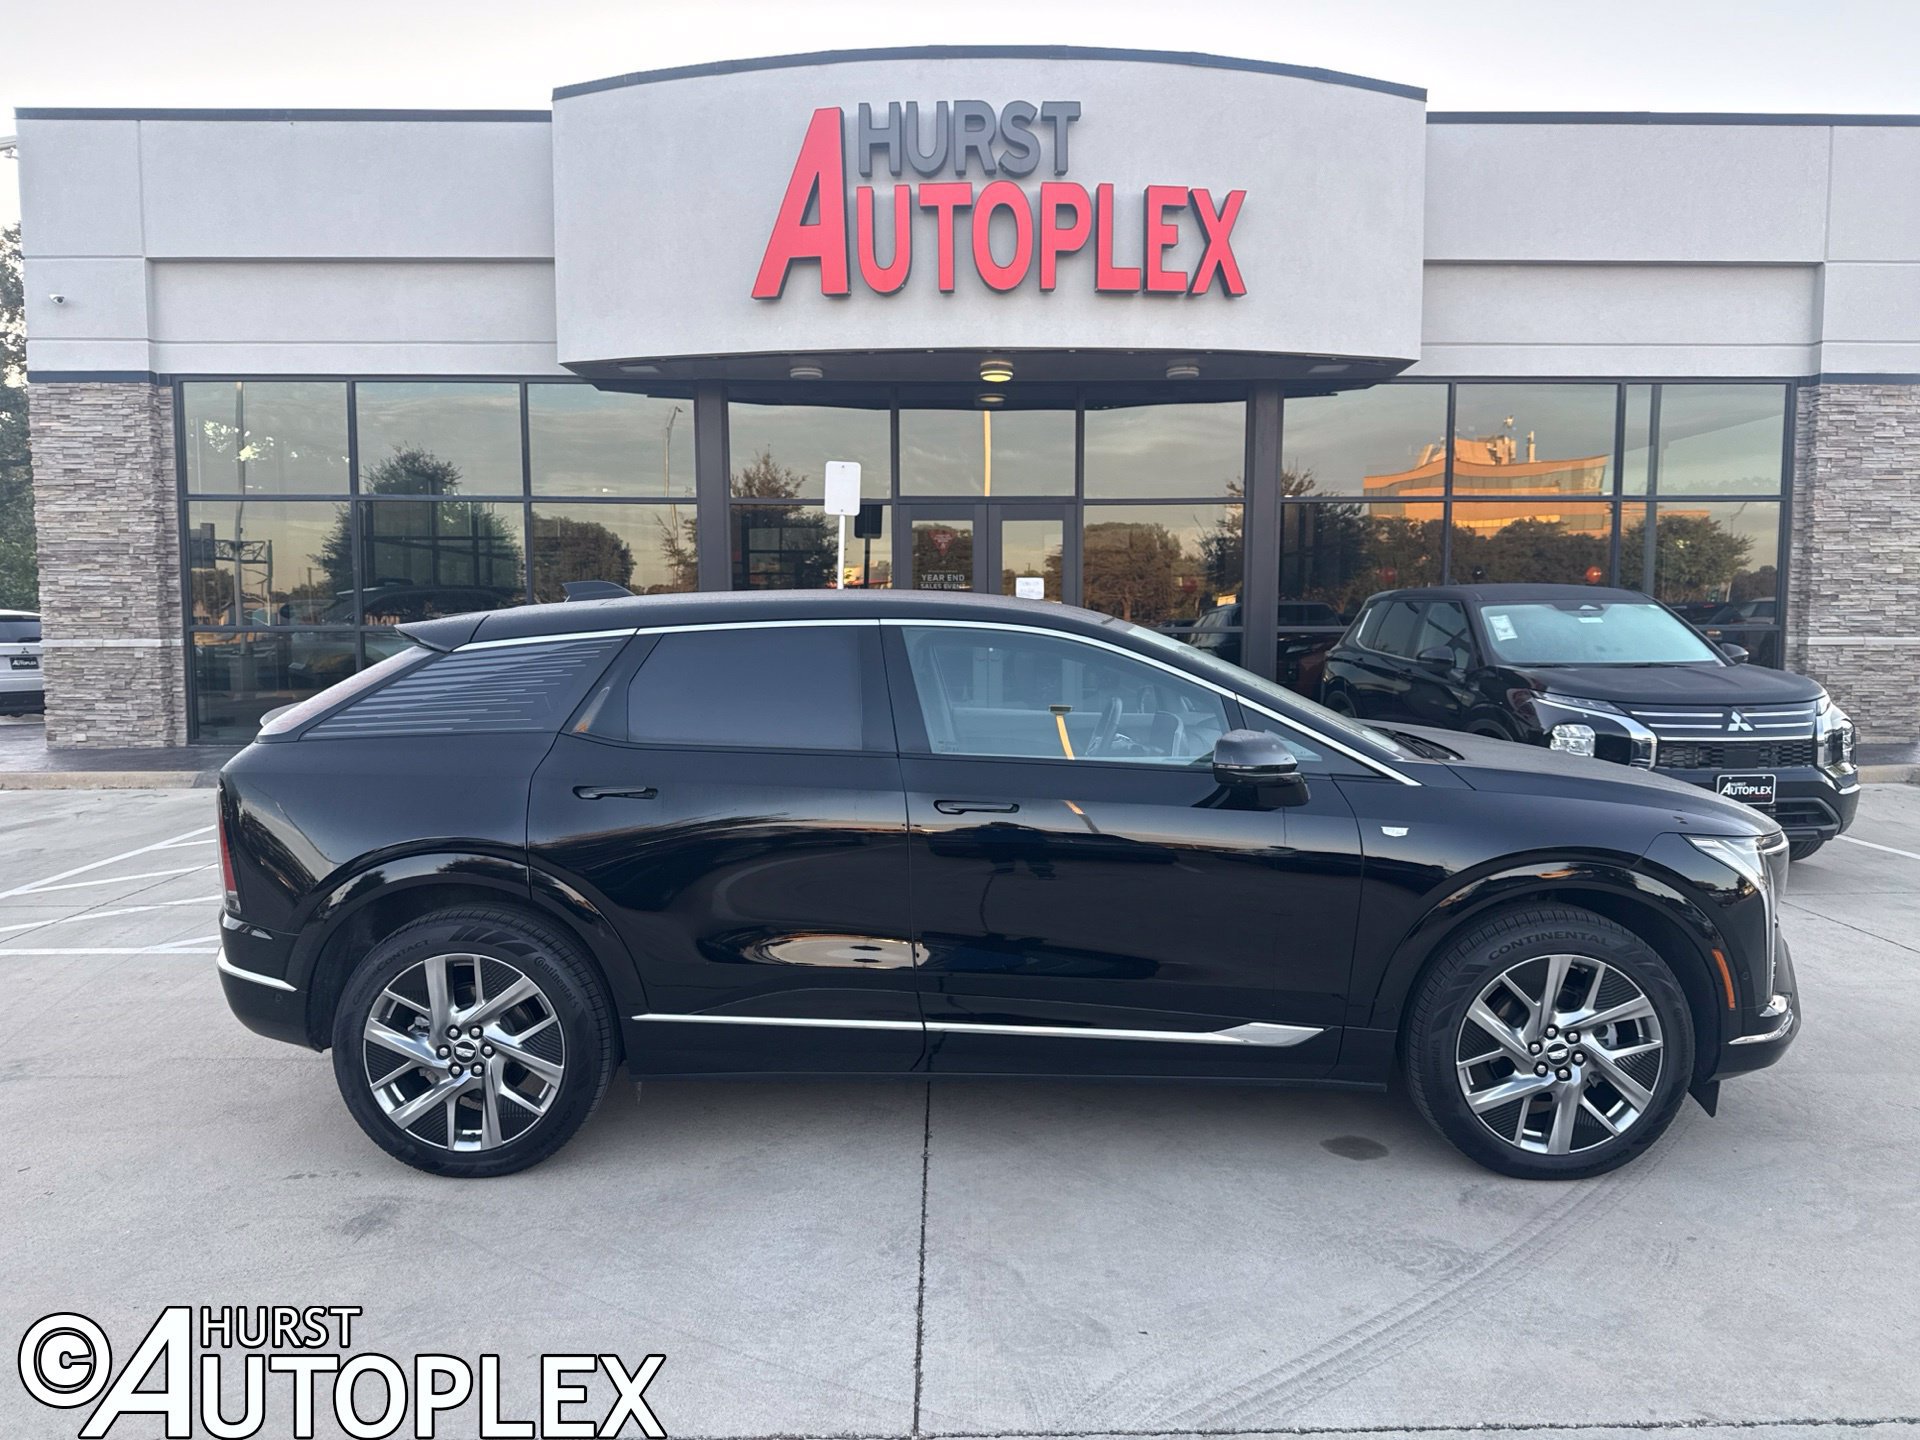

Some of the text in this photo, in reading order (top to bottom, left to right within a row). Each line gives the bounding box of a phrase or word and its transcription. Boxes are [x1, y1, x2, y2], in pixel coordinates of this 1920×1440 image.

[858, 100, 1081, 178] HURST
[751, 106, 1248, 299] AUTOPLEX
[921, 574, 965, 582] YEAR END
[1720, 783, 1772, 795] AUTOPLEX
[1489, 930, 1610, 960] CONTINENTAL
